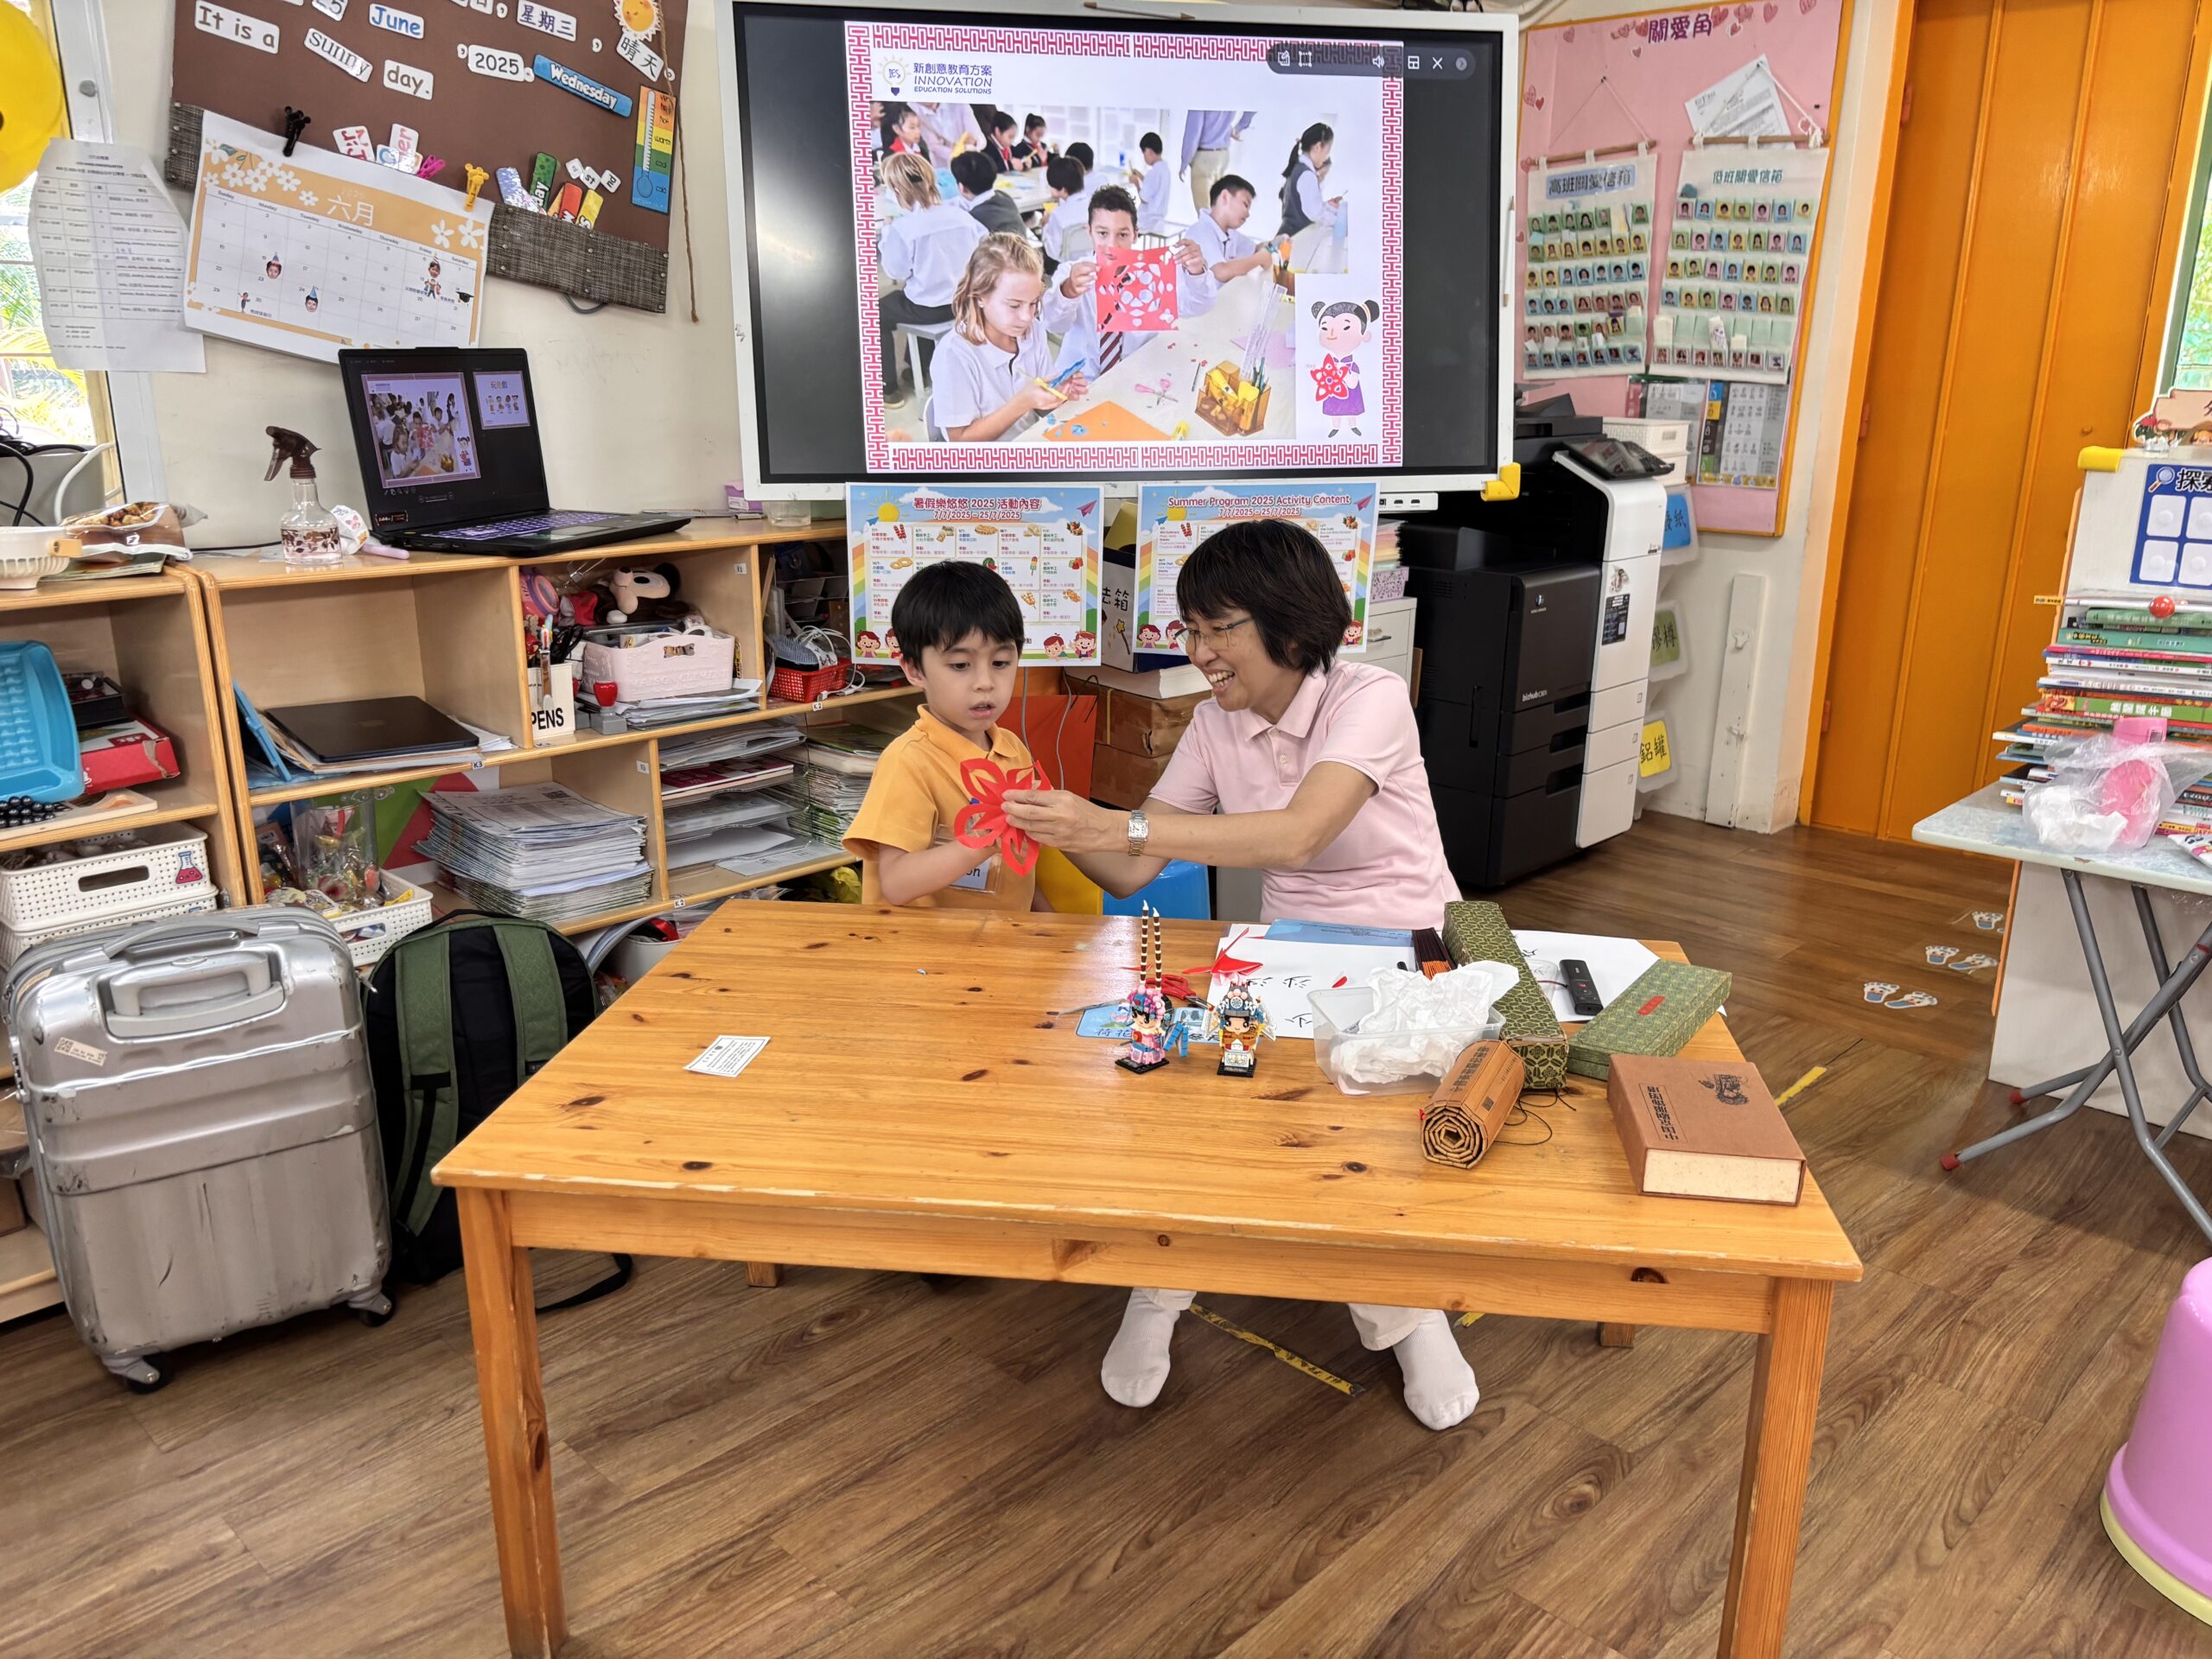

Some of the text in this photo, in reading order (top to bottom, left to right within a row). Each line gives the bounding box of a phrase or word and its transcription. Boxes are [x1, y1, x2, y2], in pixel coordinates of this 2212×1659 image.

[199, 5, 275, 48] It is a
[372, 6, 421, 36] June
[520, 4, 575, 37] 星期三
[1648, 13, 1713, 44] 關愛角
[308, 31, 370, 77] sunny
[620, 35, 658, 77] 晴天
[913, 62, 993, 76] 新創意教育方案
[914, 75, 993, 87] INNOVATION
[550, 62, 618, 111] Wednesday
[1548, 169, 1631, 196] 高班關愛信箱
[1713, 168, 1783, 185] 低班關愛信箱
[327, 194, 374, 226] 六月
[912, 497, 1042, 511] 暑假樂悠悠 2025 活動內容
[933, 510, 970, 520] 7/7/2025
[979, 510, 1021, 520] 25/7/2025
[1168, 494, 1351, 509] Summer Program 2025 Activity Content
[1218, 508, 1253, 518] 7/7/2025
[1262, 507, 1300, 517] 25/7/2025
[531, 708, 564, 730] PENS
[1640, 734, 1667, 764] 鋁罐
